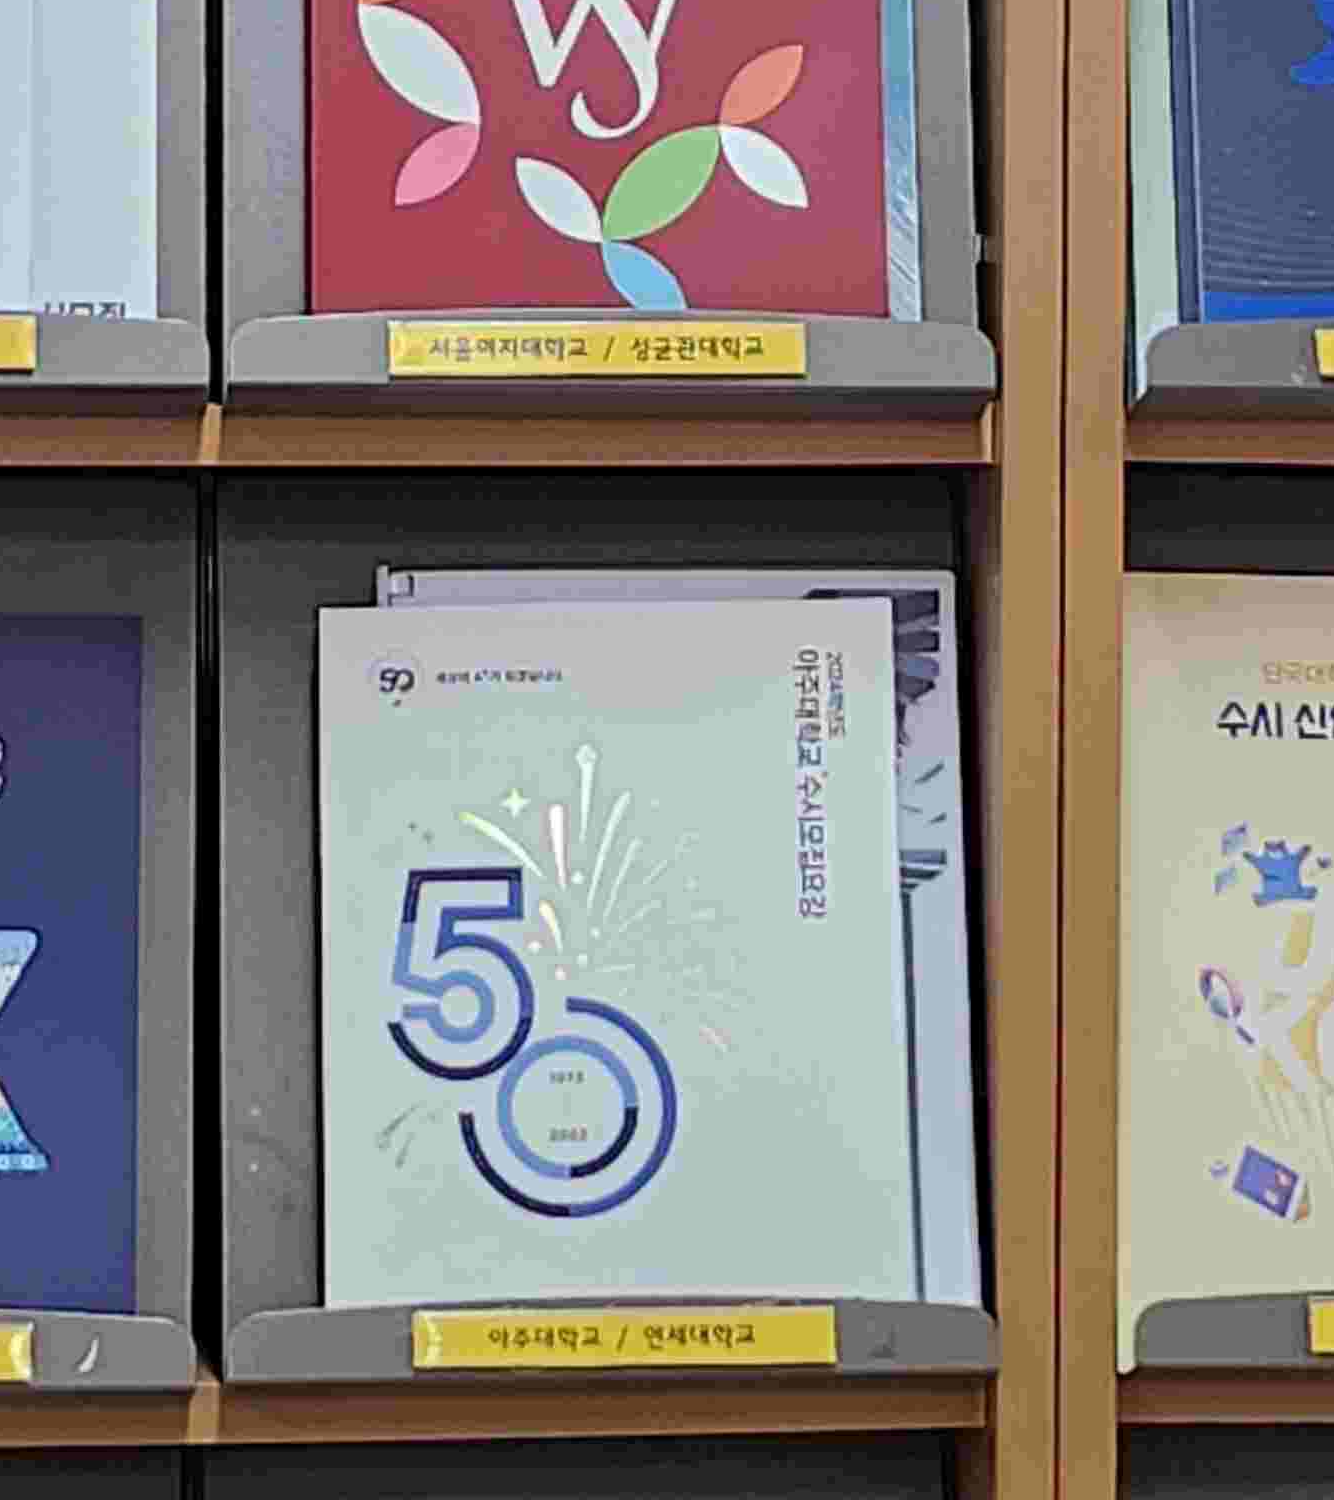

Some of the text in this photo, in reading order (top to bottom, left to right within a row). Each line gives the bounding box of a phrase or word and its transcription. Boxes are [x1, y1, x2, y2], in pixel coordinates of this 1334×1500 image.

[630, 336, 765, 363] 성균관대학교
[1217, 700, 1284, 739] 수시
[487, 1325, 602, 1353] 아주대학교
[643, 1323, 756, 1351] 연세대학교
